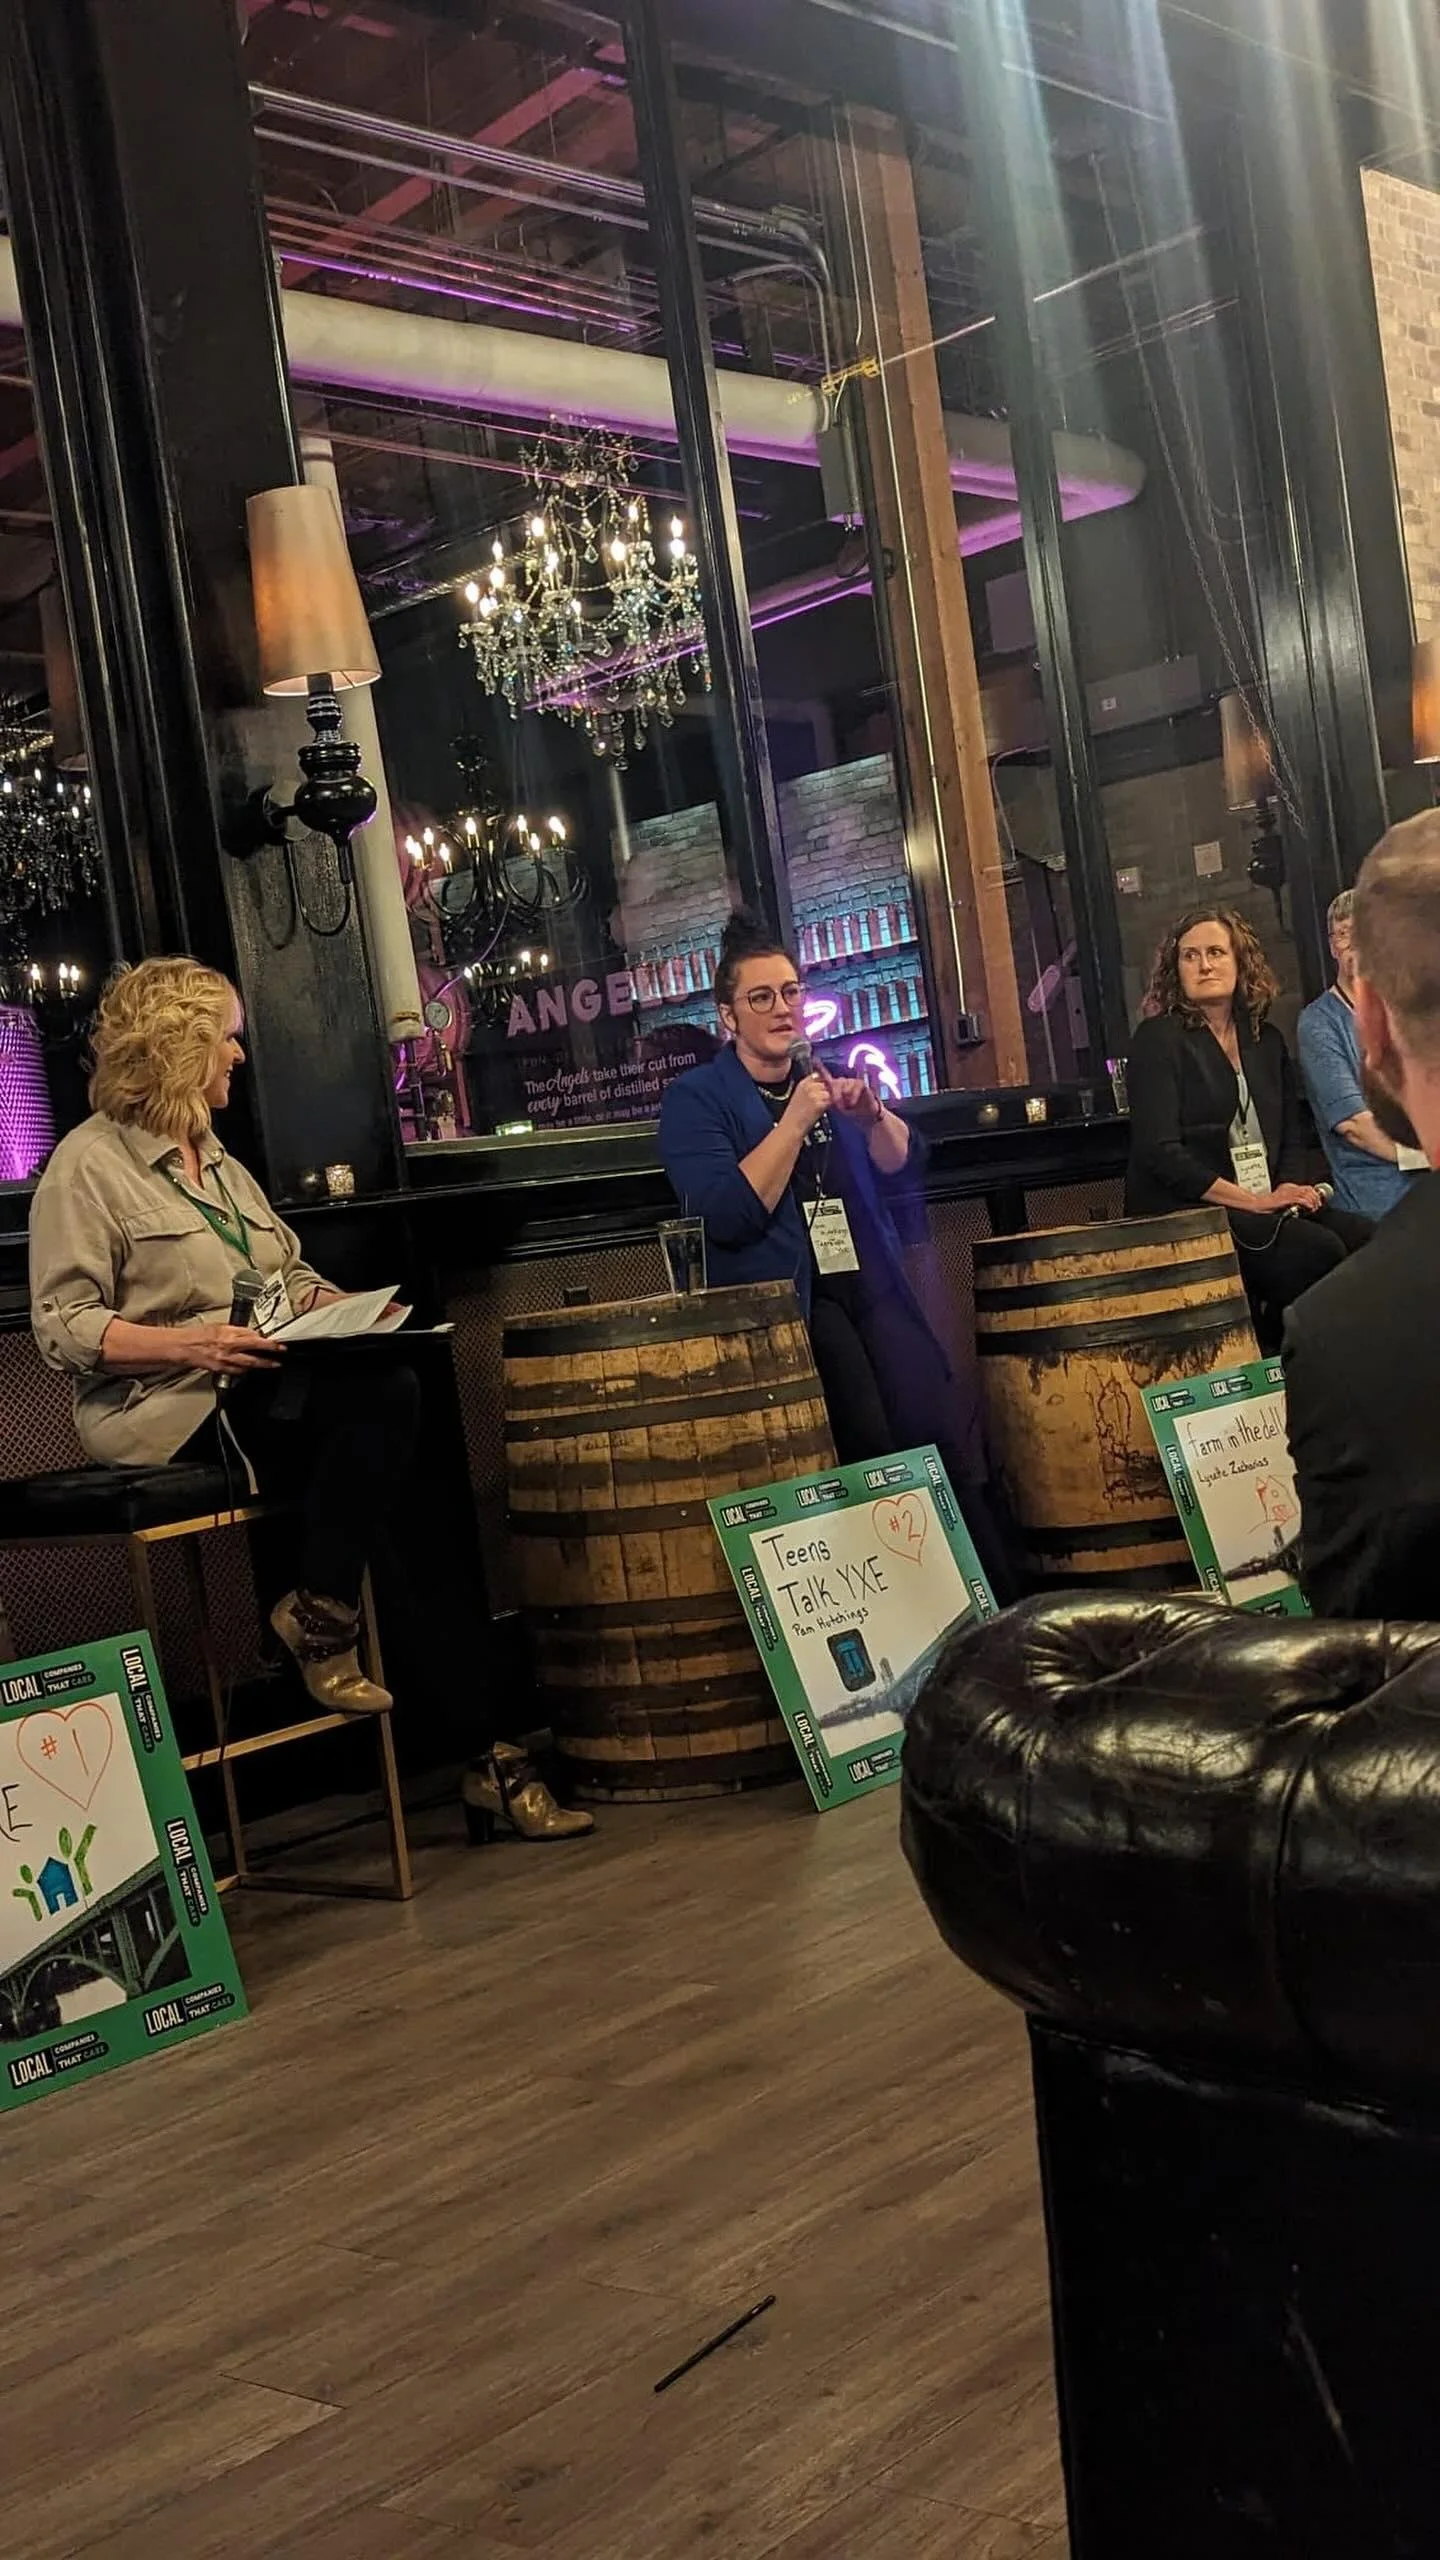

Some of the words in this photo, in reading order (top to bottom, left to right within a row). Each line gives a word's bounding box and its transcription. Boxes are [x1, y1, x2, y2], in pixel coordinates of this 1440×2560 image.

[525, 1081, 545, 1095] The
[546, 1066, 590, 1094] Angels
[593, 1067, 618, 1082] take
[620, 1062, 645, 1076] their
[648, 1056, 667, 1070] cut
[669, 1052, 697, 1068] from
[527, 1095, 562, 1116] every
[564, 1089, 598, 1107] barrel
[600, 1086, 612, 1099] of
[614, 1077, 660, 1098] distilled
[1235, 1414, 1262, 1444] the
[925, 1456, 942, 1487] LOCAL
[721, 1505, 747, 1526] LOCAL
[888, 1510, 921, 1542] #2
[761, 1533, 831, 1570] Teens
[741, 1568, 761, 1601] LOCAL
[777, 1575, 840, 1617] Talk
[836, 1556, 888, 1601] YXE
[971, 1580, 989, 1610] LOCAL
[792, 1623, 815, 1637] Pam
[816, 1607, 869, 1629] Hutchings
[122, 1648, 148, 1692] LOCAL
[2, 1675, 42, 1704] LOCAL
[47, 1680, 70, 1693] THAT
[134, 1697, 147, 1723] THAT
[795, 1712, 815, 1748] LOCAL
[0, 1784, 33, 1842] E
[167, 1820, 193, 1865] LOCAL
[180, 1870, 192, 1897] THAT
[145, 2002, 184, 2034] LOCAL
[188, 2004, 211, 2018] THAT
[11, 2052, 53, 2086] LOCAL
[58, 2054, 82, 2069] THAT
